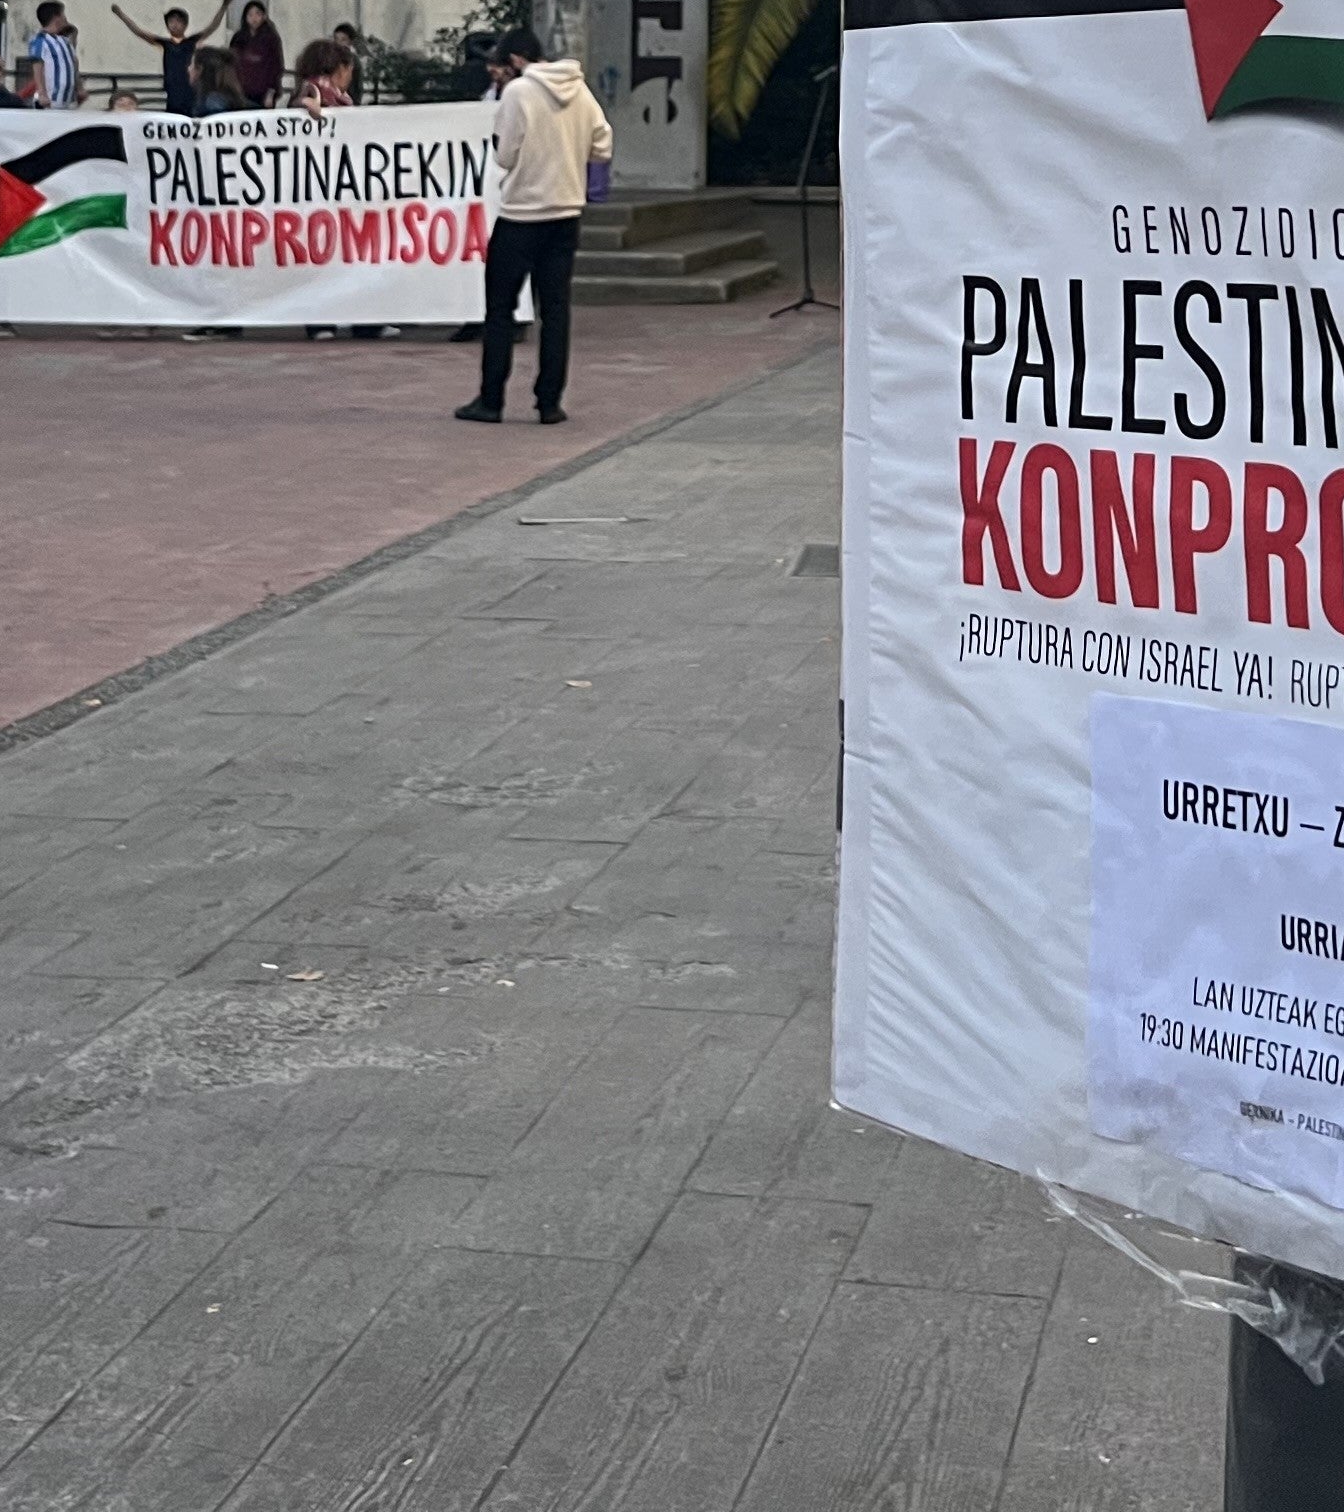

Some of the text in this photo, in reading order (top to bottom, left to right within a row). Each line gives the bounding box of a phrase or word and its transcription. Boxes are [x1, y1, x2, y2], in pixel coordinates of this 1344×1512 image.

[143, 116, 336, 141] GENOZIDIOA STOP!
[146, 138, 489, 206] PALESTINAREKIN
[149, 202, 489, 268] KONPROMISOA
[959, 613, 1073, 670] ¡RUPTURA
[1082, 630, 1131, 678] CON
[1139, 638, 1223, 692] ISRAEL
[1233, 650, 1274, 700] YA!
[1163, 779, 1289, 838] URRETXU
[1140, 1012, 1184, 1050] 19:30
[1193, 977, 1234, 1013] LAN
[1241, 986, 1317, 1030] UZTEAK
